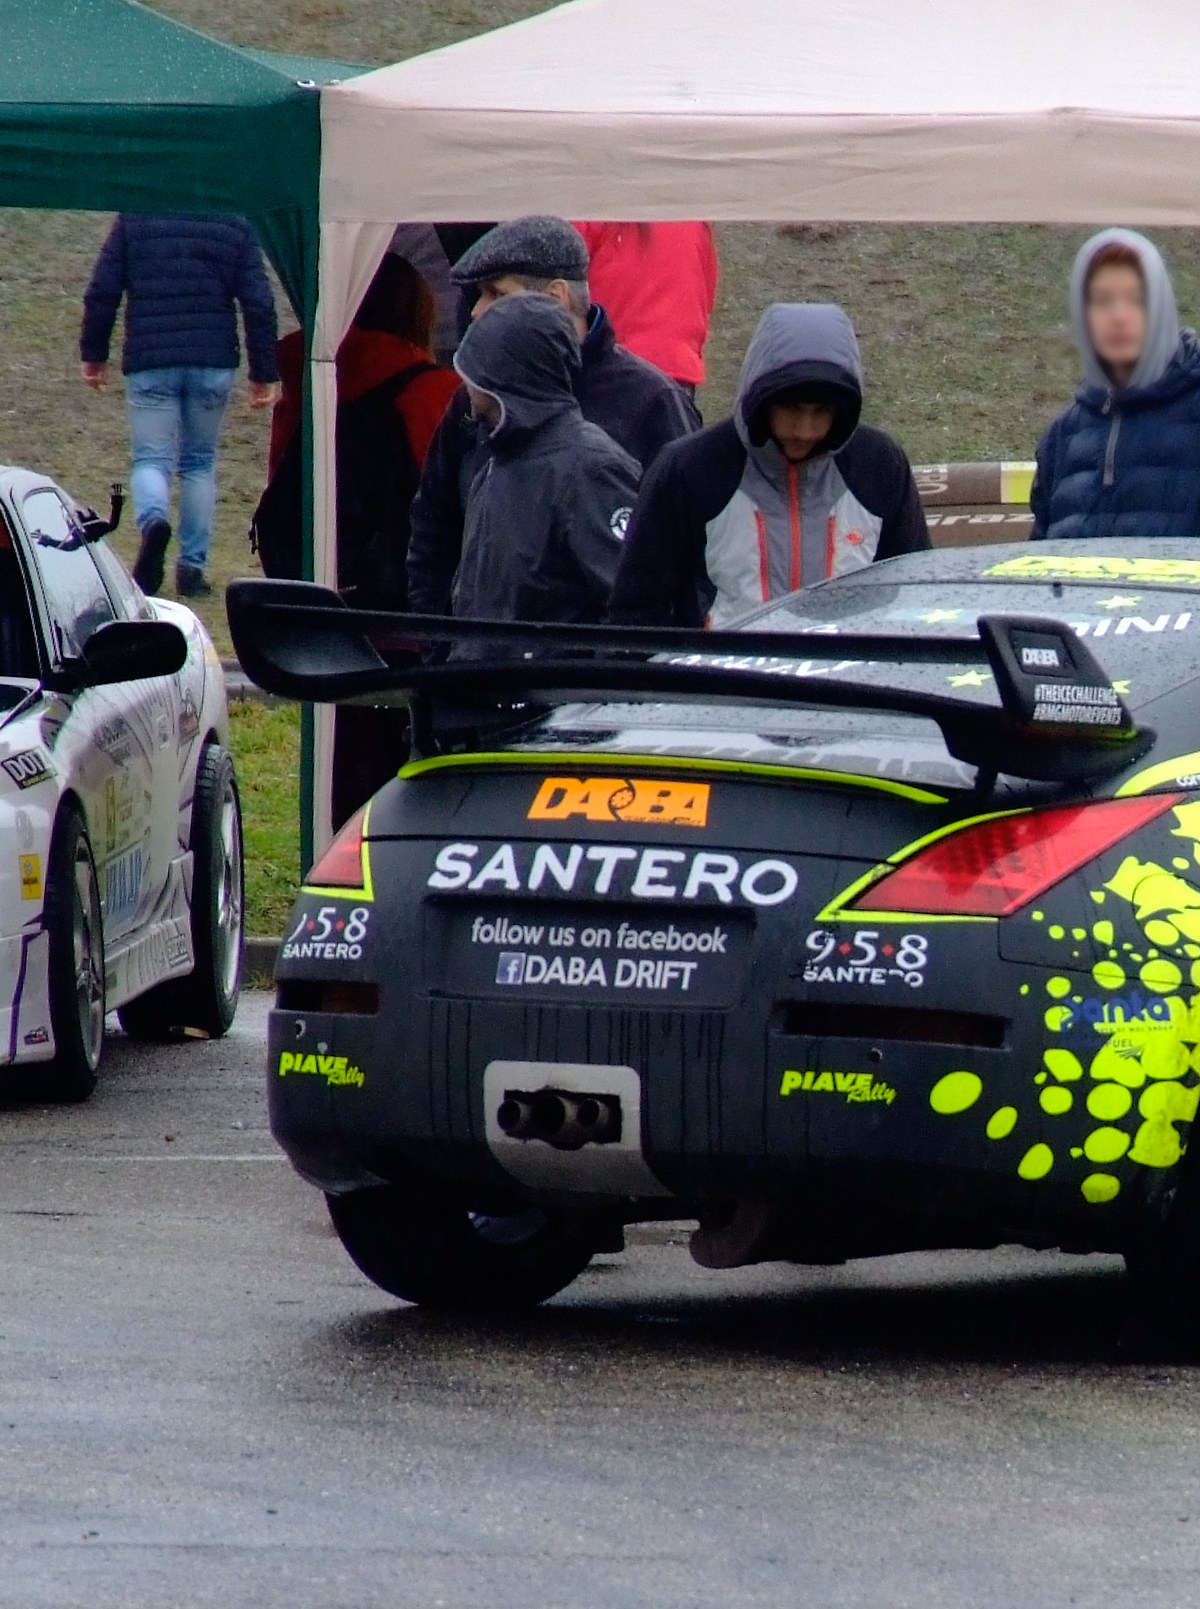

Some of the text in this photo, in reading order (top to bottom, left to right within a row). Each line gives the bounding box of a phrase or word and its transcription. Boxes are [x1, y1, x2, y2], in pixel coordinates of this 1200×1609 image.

[427, 843, 799, 906] SANTERO
[282, 943, 362, 960] SANTERO
[471, 917, 728, 954] follow us on facebook
[525, 955, 607, 988] DABA
[615, 959, 698, 991] DRIFT
[279, 1052, 366, 1088] PIAVE Rally
[780, 1070, 897, 1106] PIAVE Rally
